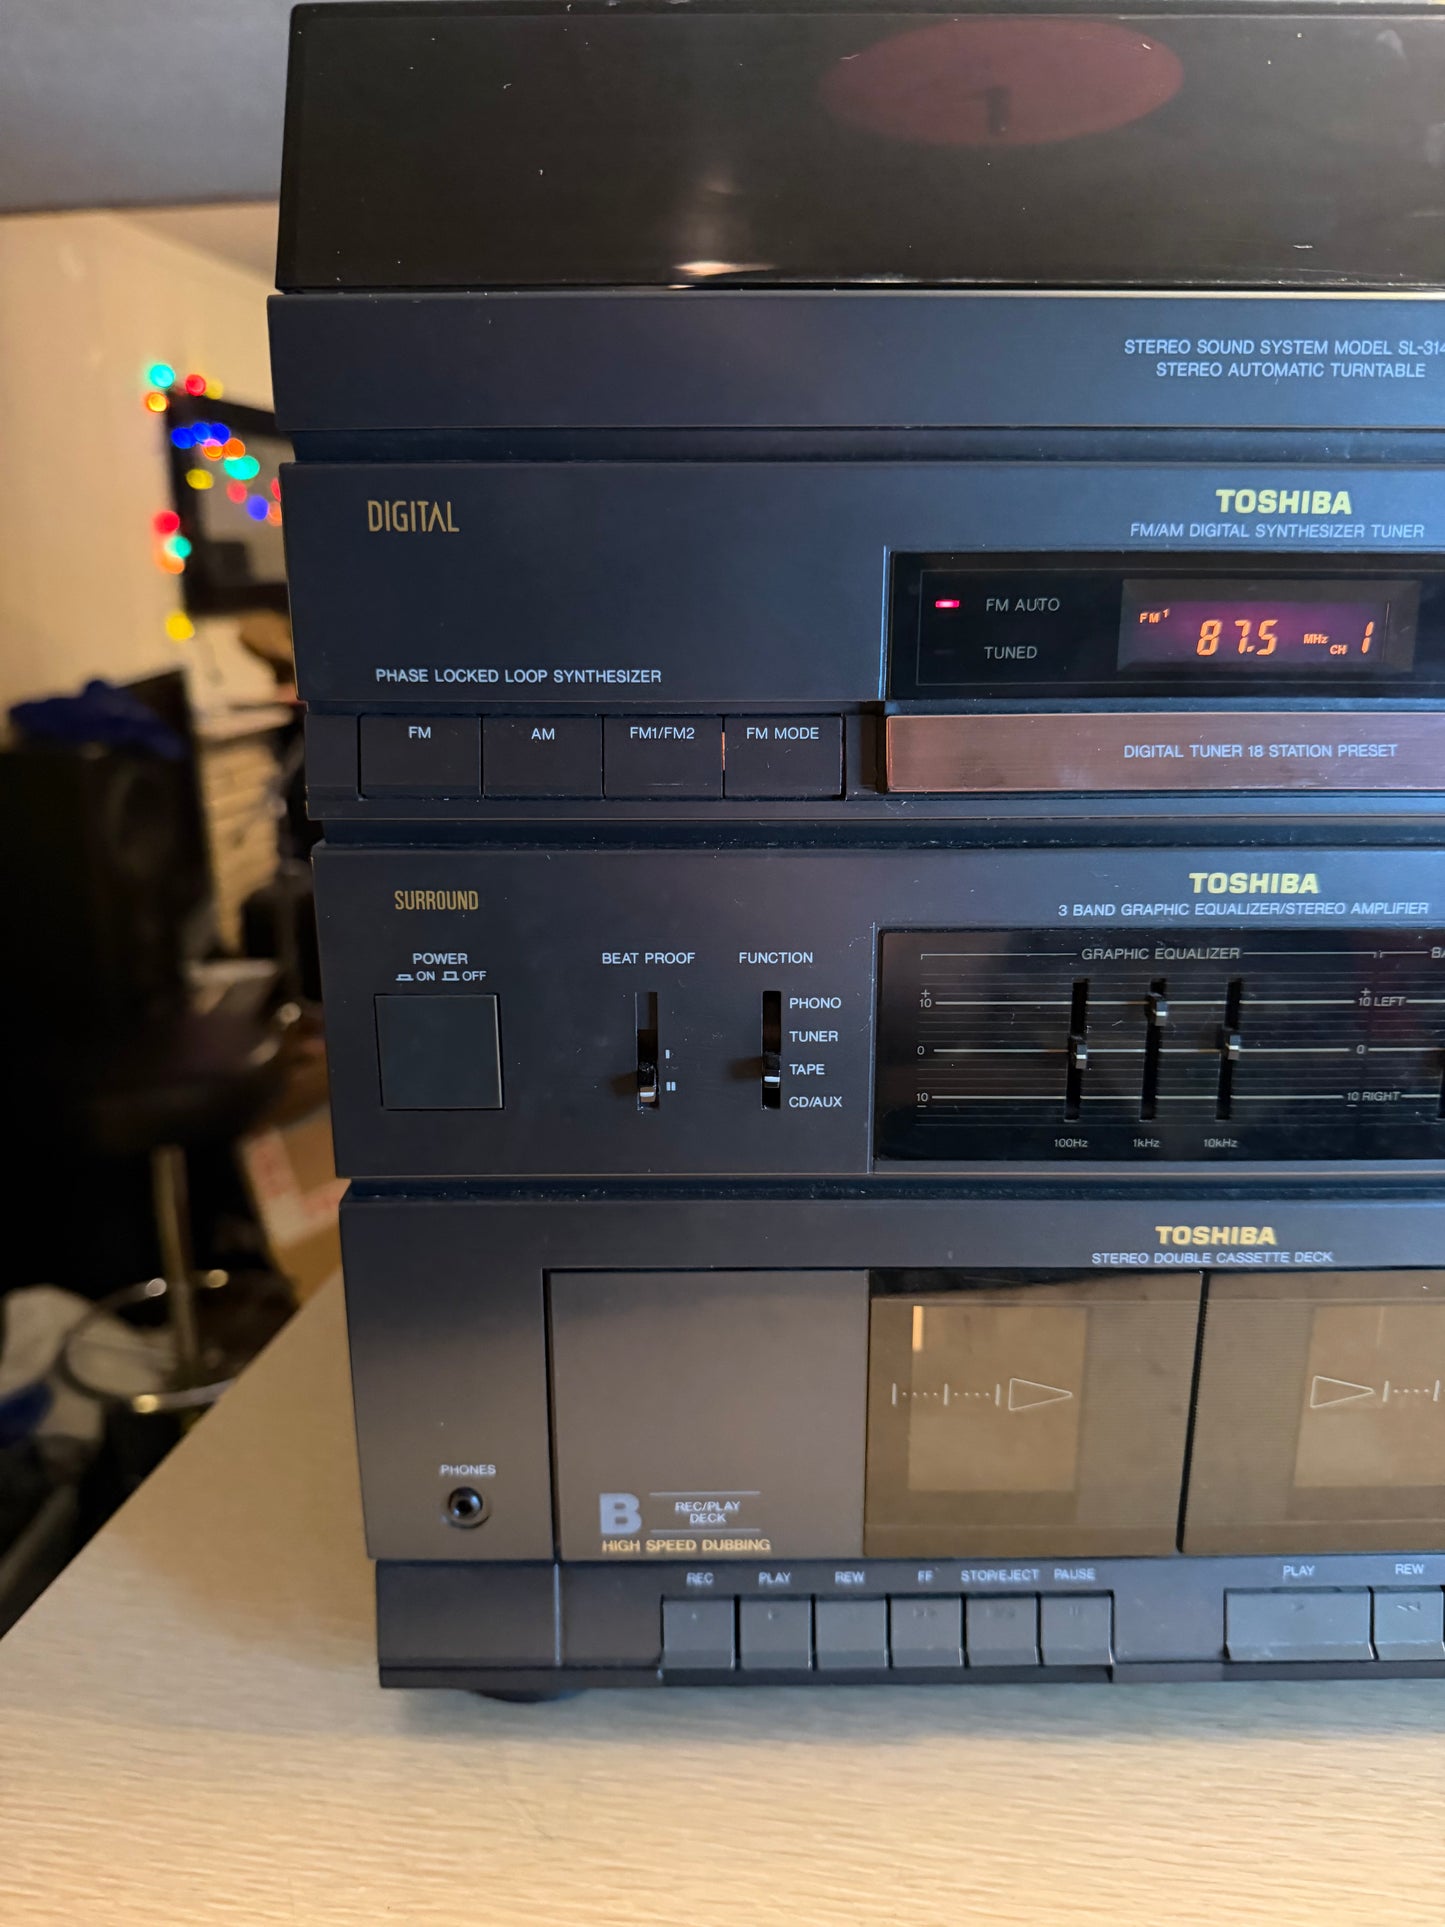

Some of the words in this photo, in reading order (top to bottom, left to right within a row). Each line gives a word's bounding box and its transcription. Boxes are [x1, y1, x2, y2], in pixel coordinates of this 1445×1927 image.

[1124, 340, 1190, 355] STEREO
[1197, 340, 1254, 355] SOUND
[1260, 340, 1328, 355] SYSTEM
[1335, 341, 1391, 355] MODEL
[1156, 362, 1222, 377] STEREO
[1229, 363, 1324, 377] AUTOMATIC
[1331, 363, 1426, 378] TURNTABLE
[1215, 489, 1352, 515] TOSHIBA
[367, 501, 459, 533] DIGITAL
[1130, 523, 1183, 537] FM/AM
[1189, 524, 1249, 538] DIGITAL
[1255, 524, 1365, 538] SYNTHESIZER
[1371, 525, 1424, 538] TUNER
[986, 599, 1009, 612] FM
[1014, 598, 1061, 613] AUTO
[1197, 620, 1278, 656] 87.5
[1304, 634, 1328, 644] MHz
[1361, 621, 1374, 654] 1
[984, 646, 1037, 659] TUNED
[1330, 645, 1347, 655] CH
[376, 668, 429, 683] PHASE
[434, 668, 499, 683] LOCKED
[505, 669, 548, 684] LOOP
[554, 669, 662, 684] SYNTHESIZER
[408, 727, 431, 739] FM
[531, 728, 555, 740] AM
[630, 727, 695, 740] FM1/FM2
[746, 727, 769, 740] FM
[774, 727, 819, 740] MODE
[1124, 744, 1184, 759] DIGITAL
[1189, 744, 1243, 758] TUNER
[1248, 744, 1263, 758] 18
[1268, 744, 1333, 758] STATION
[1338, 744, 1397, 758] PRESET
[1189, 872, 1319, 894] TOSHIBA
[395, 890, 479, 911] SURROUND
[1058, 904, 1068, 917] 3
[1073, 903, 1116, 916] BAND
[1120, 903, 1189, 917] GRAPHIC
[1194, 903, 1345, 916] EQUALIZER/STEREO
[1351, 902, 1428, 916] AMPLIFIER
[412, 953, 468, 966] POWER
[602, 952, 639, 965] BEAT
[644, 952, 695, 965] PROOF
[739, 952, 813, 964] FUNCTION
[1081, 947, 1149, 961] GRAPHIC
[1154, 947, 1240, 961] EQUALIZER
[416, 970, 436, 982] ON
[462, 970, 486, 981] OFF
[789, 997, 842, 1009] PHONO
[920, 998, 932, 1008] 10
[1359, 996, 1371, 1007] 10
[1373, 996, 1406, 1007] LEFT
[789, 1031, 838, 1042] TUNER
[917, 1045, 925, 1055] 0
[1356, 1044, 1366, 1054] 0
[789, 1064, 825, 1075] TAPE
[789, 1096, 842, 1108] CD/AUX
[916, 1092, 929, 1102] 10
[1347, 1091, 1359, 1101] 10
[1362, 1091, 1401, 1102] RIGHT
[1054, 1138, 1088, 1148] 100Hz
[1132, 1138, 1160, 1148] 1kHz
[1203, 1138, 1237, 1148] 10kHz
[1155, 1226, 1277, 1246] TOSHIBA
[1092, 1253, 1149, 1264] STEREO
[1154, 1252, 1212, 1264] DOUBLE
[1216, 1252, 1291, 1263] CASSETTE
[1295, 1251, 1334, 1263] DECK
[439, 1464, 496, 1476] PHONES
[675, 1501, 740, 1513] REC/PLAY
[600, 1493, 641, 1534] B
[689, 1513, 726, 1524] DECK
[602, 1539, 640, 1552] HIGH
[646, 1539, 696, 1552] SPEED
[702, 1539, 771, 1552] DUBBING
[1054, 1569, 1095, 1581] PAUSE
[1283, 1565, 1315, 1577] PLAY
[1395, 1564, 1425, 1576] REW
[686, 1572, 713, 1585] REC
[759, 1572, 791, 1585] PLAY
[835, 1571, 865, 1585] REW
[918, 1571, 933, 1583] FF
